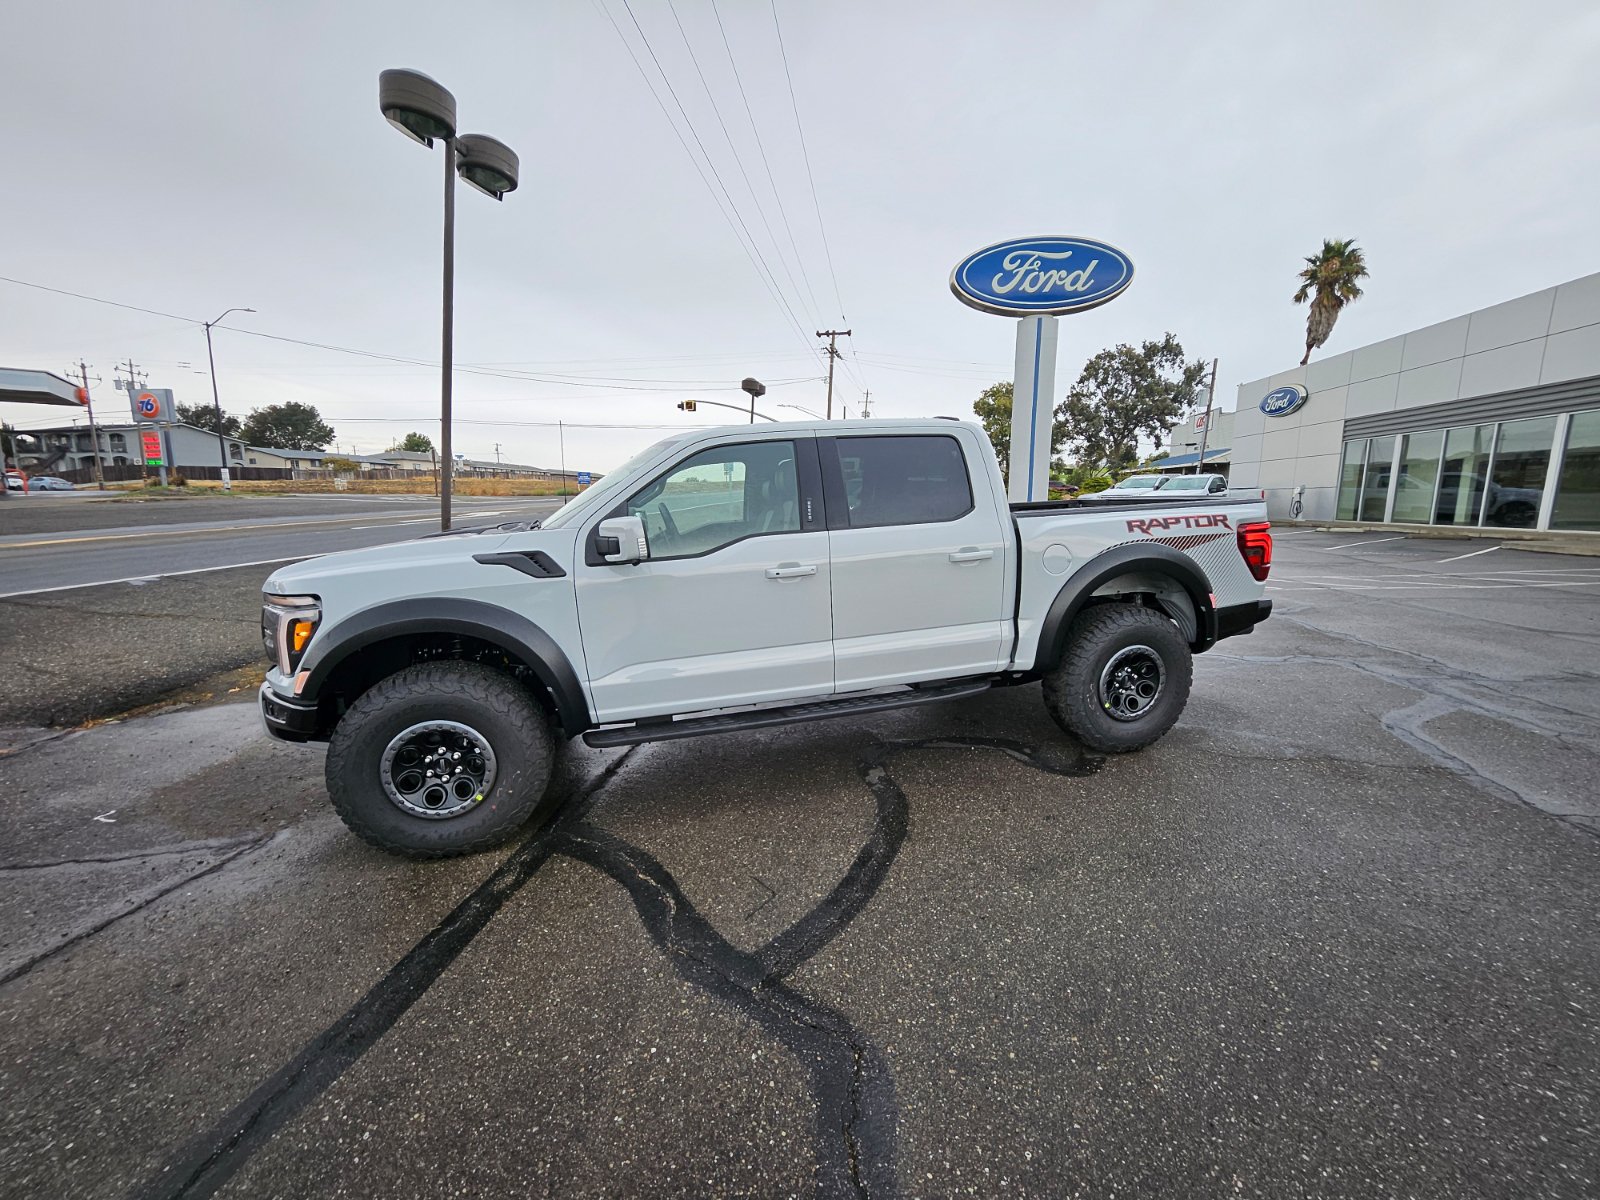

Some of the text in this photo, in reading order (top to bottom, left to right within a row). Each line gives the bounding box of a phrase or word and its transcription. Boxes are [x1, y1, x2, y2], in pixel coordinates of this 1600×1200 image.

[991, 250, 1099, 294] Ford
[138, 398, 154, 413] 76
[1265, 392, 1290, 412] Ford
[1126, 514, 1234, 536] RAPTOR
